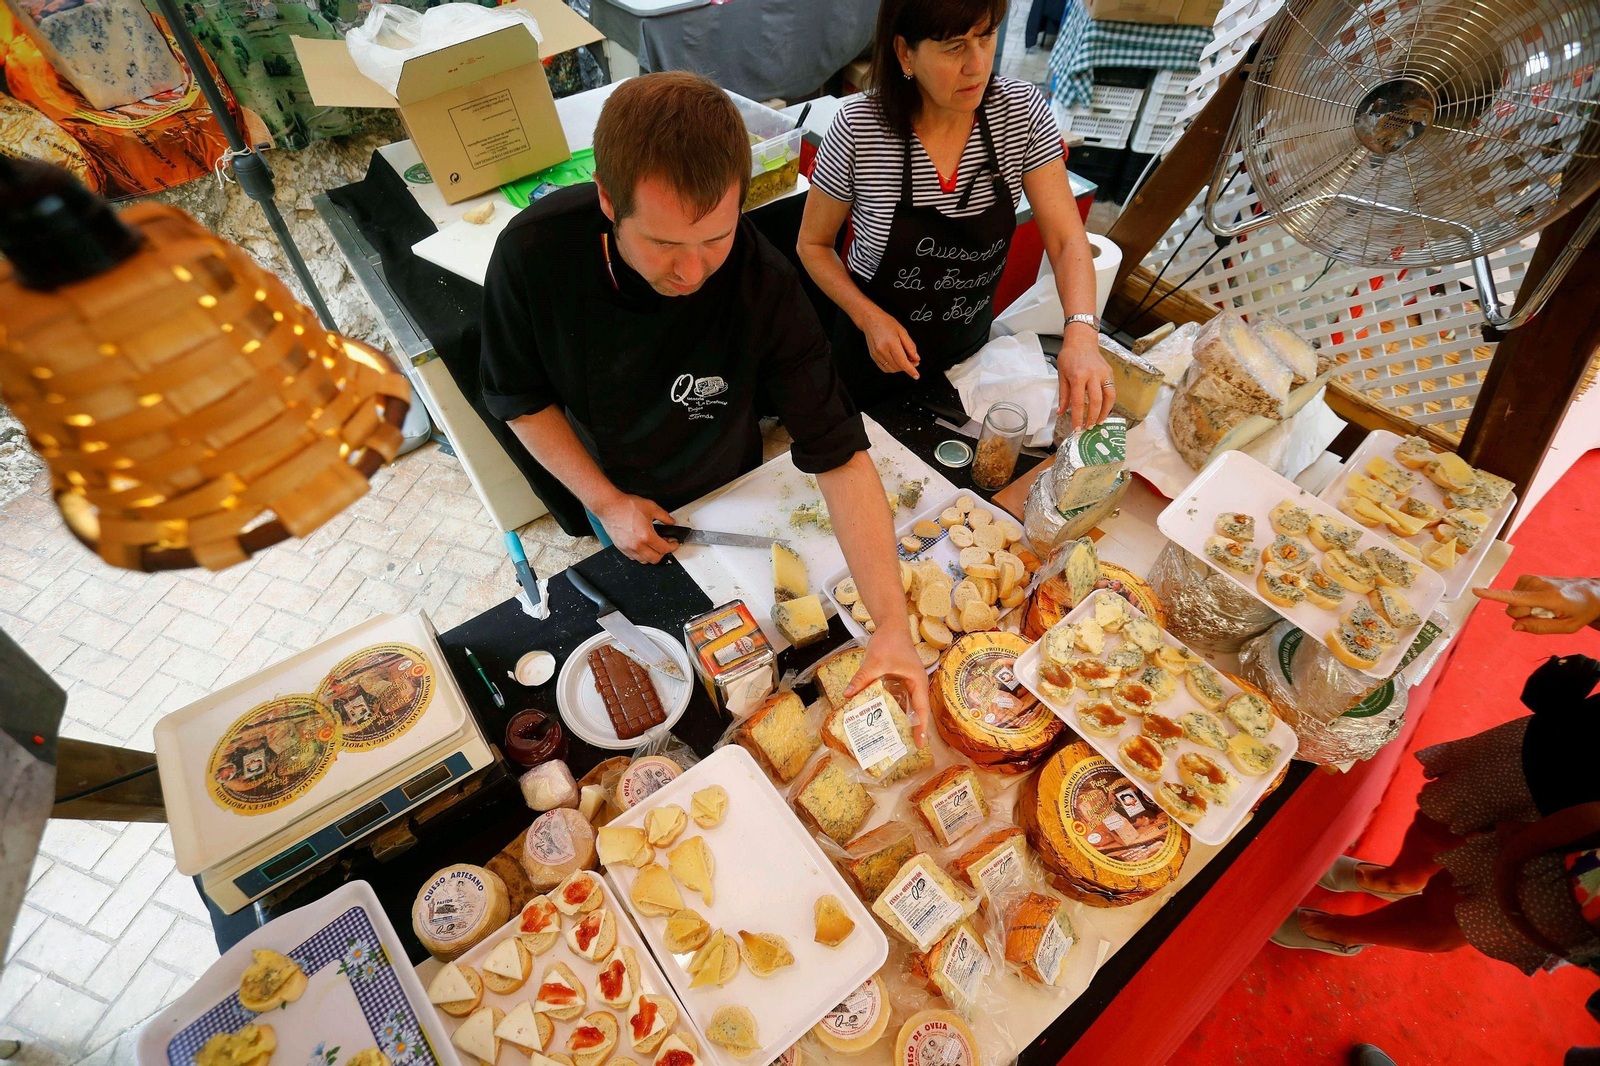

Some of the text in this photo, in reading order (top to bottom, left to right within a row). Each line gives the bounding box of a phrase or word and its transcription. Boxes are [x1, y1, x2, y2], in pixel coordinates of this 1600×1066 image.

[893, 266, 926, 290] La
[910, 303, 933, 321] de
[397, 724, 407, 732] DE
[366, 732, 395, 746] ORIGEN
[1080, 765, 1088, 773] DE
[1088, 759, 1109, 768] ORIGE
[623, 778, 632, 798] OVEJA
[247, 800, 279, 811] ORIGEN
[282, 793, 292, 803] DE
[424, 871, 484, 902] QUESO ARTESANO
[907, 1022, 948, 1066] ESO DE OVEJA
